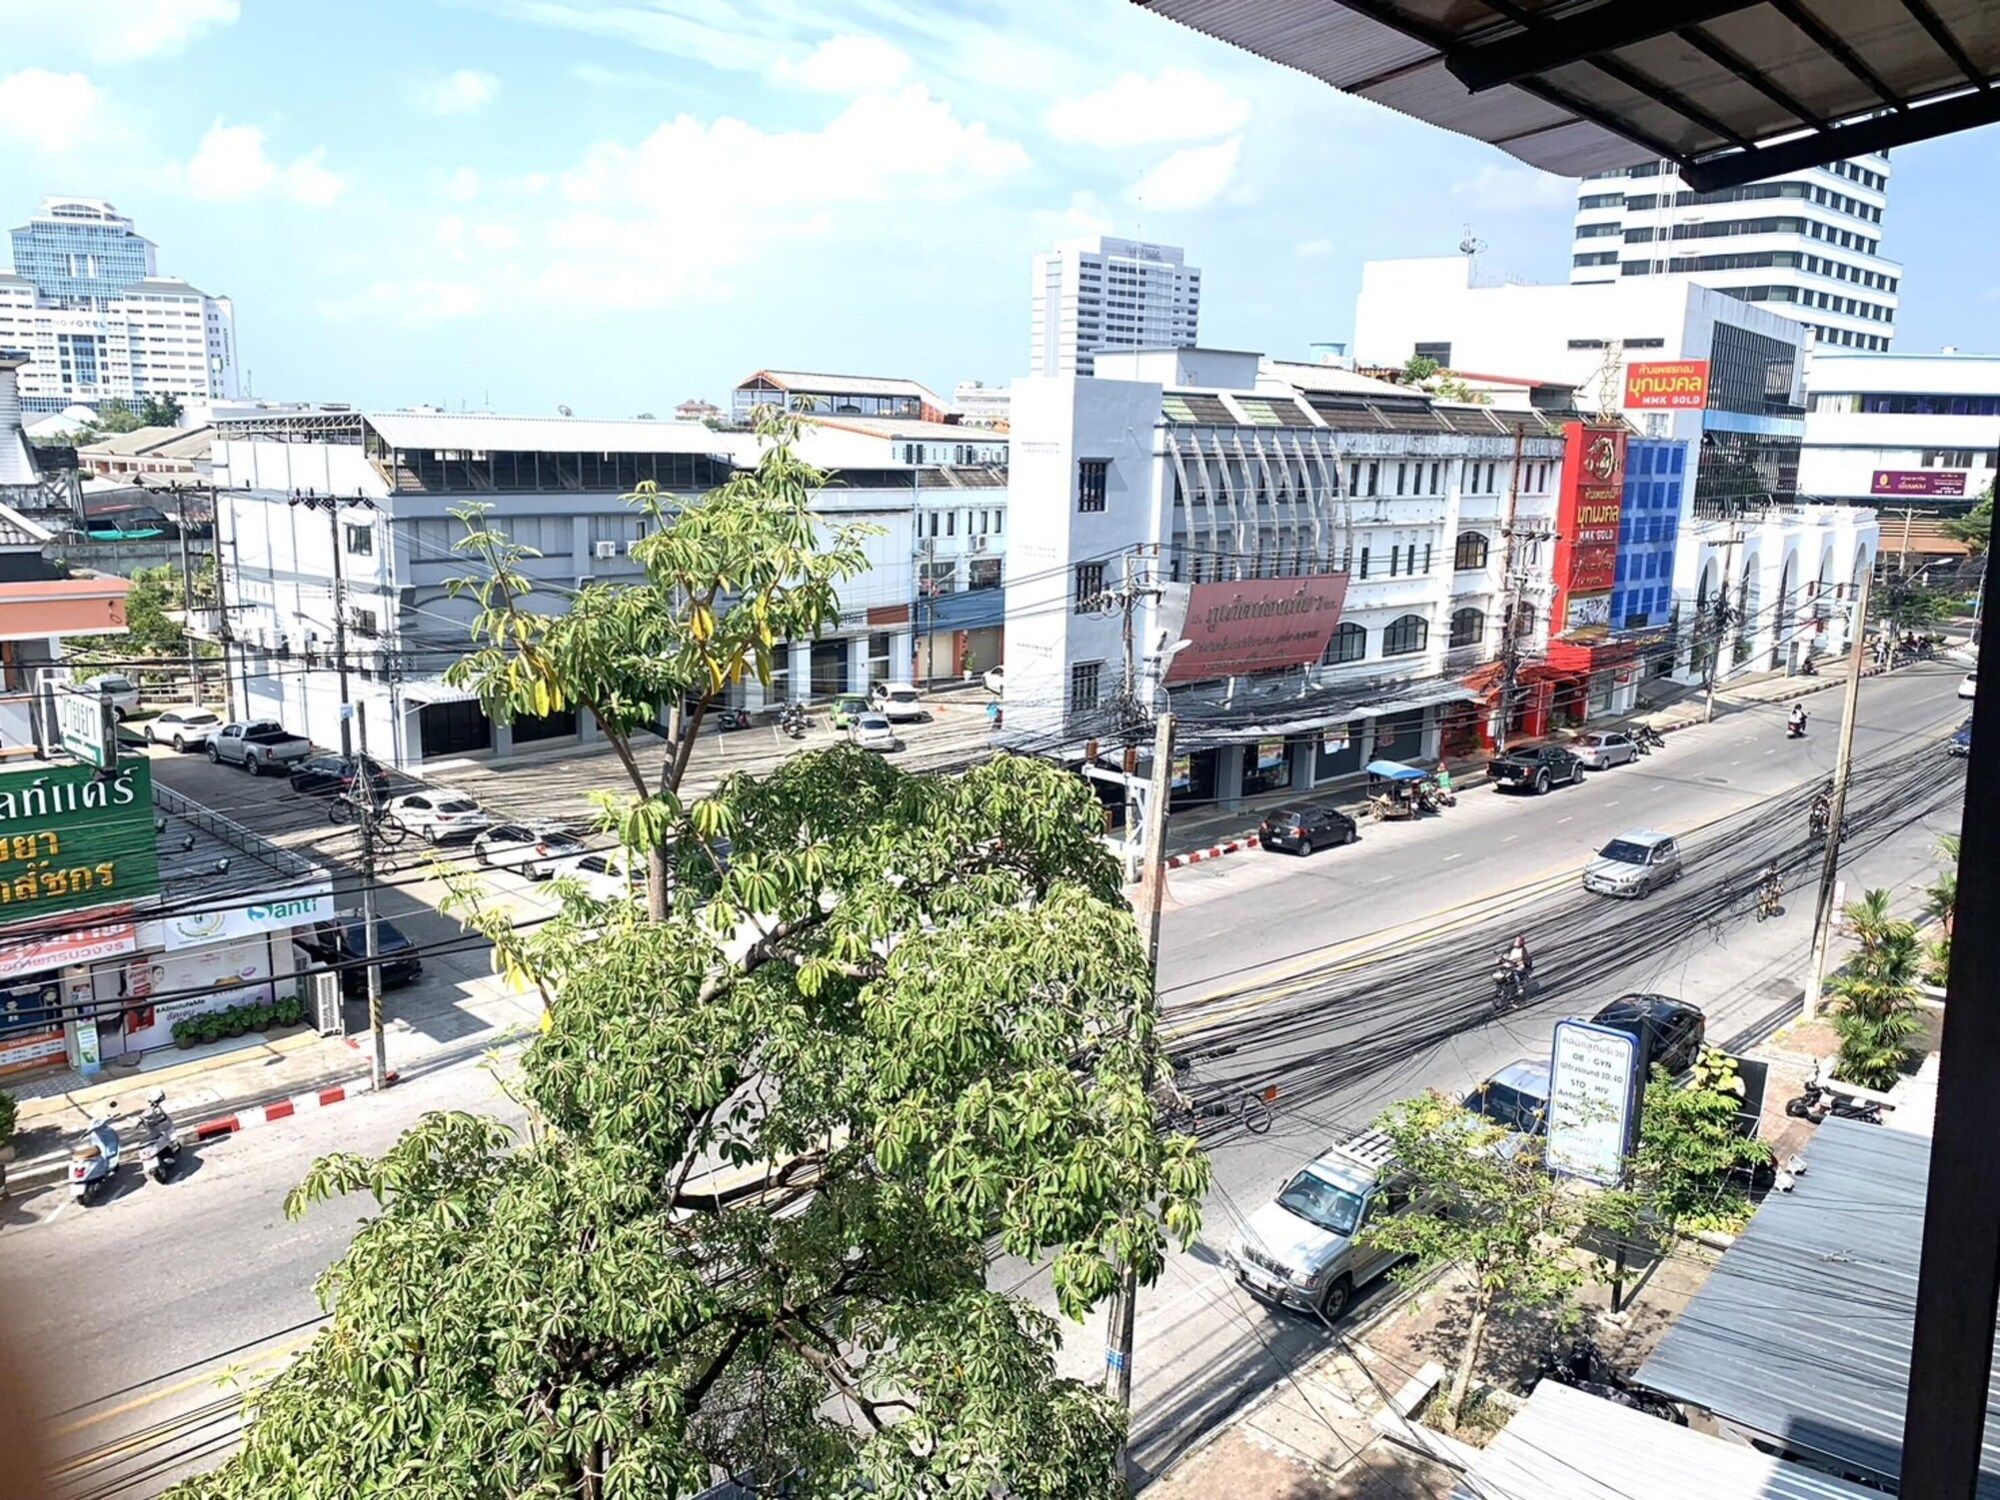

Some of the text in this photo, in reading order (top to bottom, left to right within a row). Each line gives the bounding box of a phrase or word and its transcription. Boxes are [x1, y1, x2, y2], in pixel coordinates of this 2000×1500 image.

[1628, 375, 1703, 399] มุกมงคล
[1641, 394, 1700, 405] MMK GOLD
[1576, 505, 1620, 530] มุกมงคล
[1593, 1058, 1612, 1069] GYN
